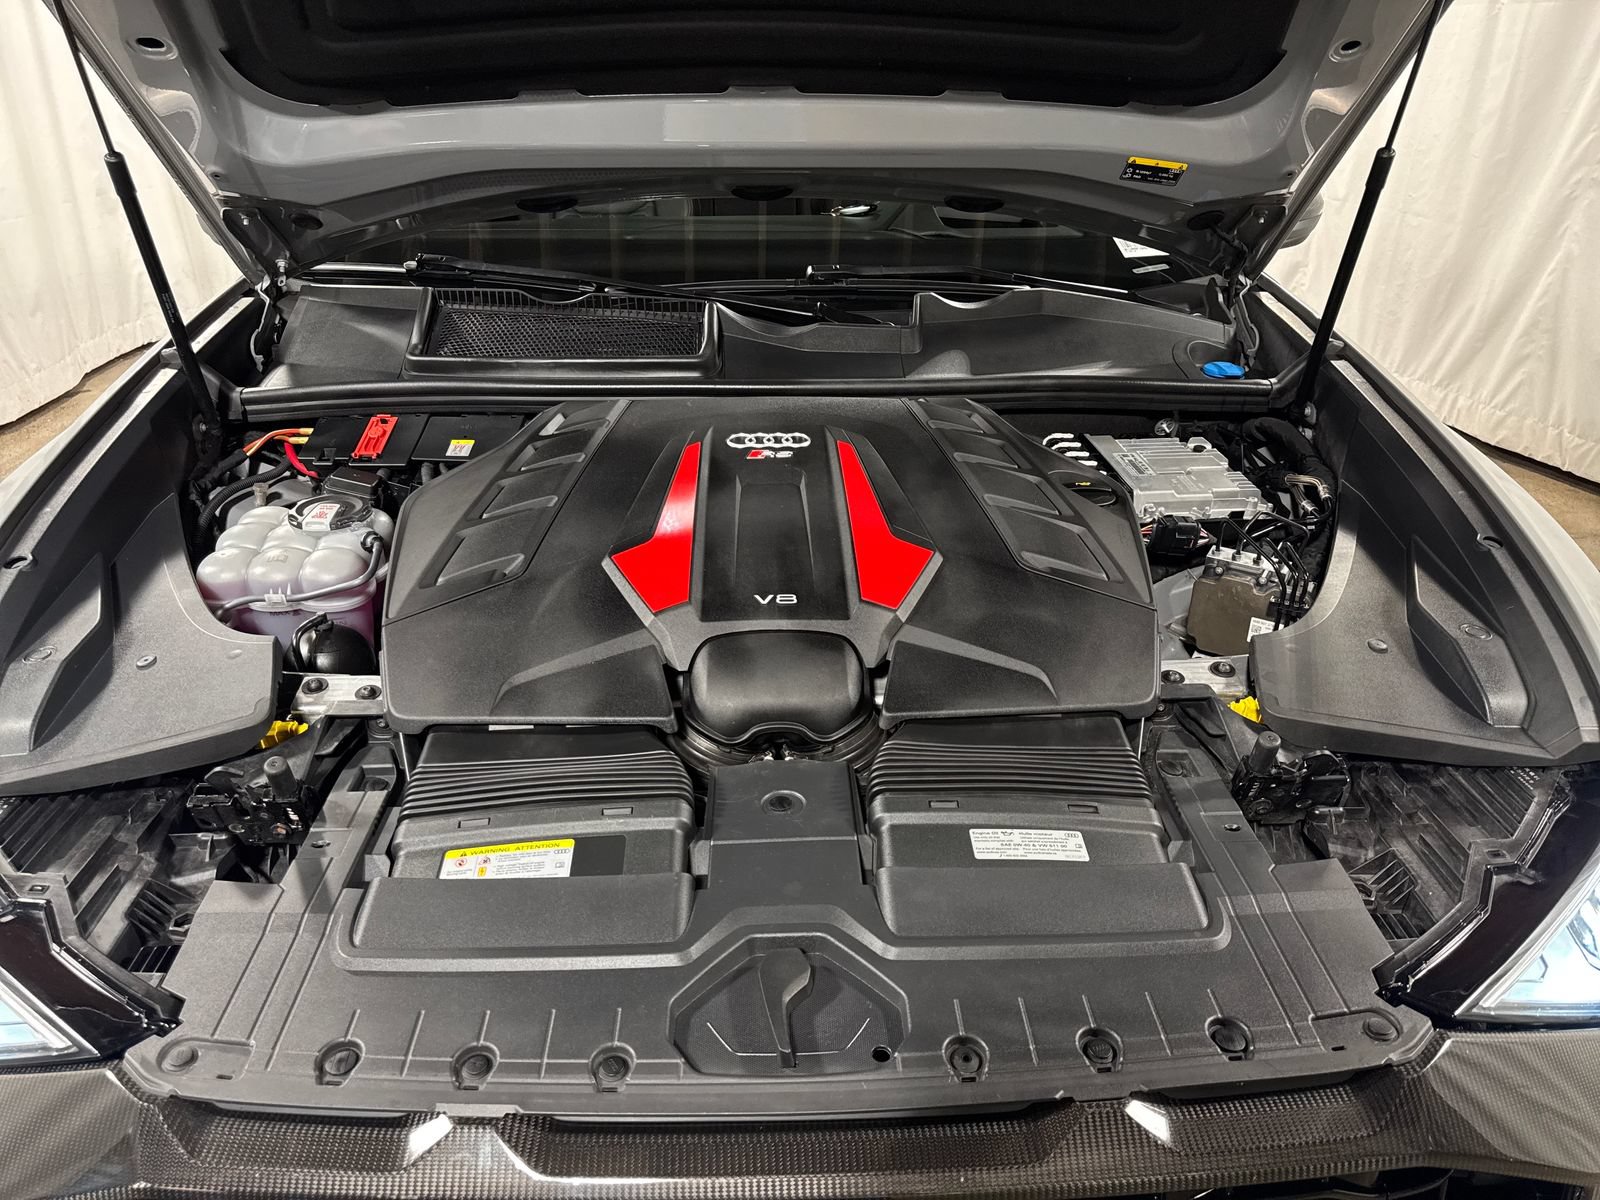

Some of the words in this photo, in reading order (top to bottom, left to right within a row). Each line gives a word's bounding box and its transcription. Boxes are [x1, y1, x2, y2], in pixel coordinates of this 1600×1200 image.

[753, 594, 798, 604] V8
[470, 847, 510, 856] WARNING
[515, 843, 561, 851] ATTENTION
